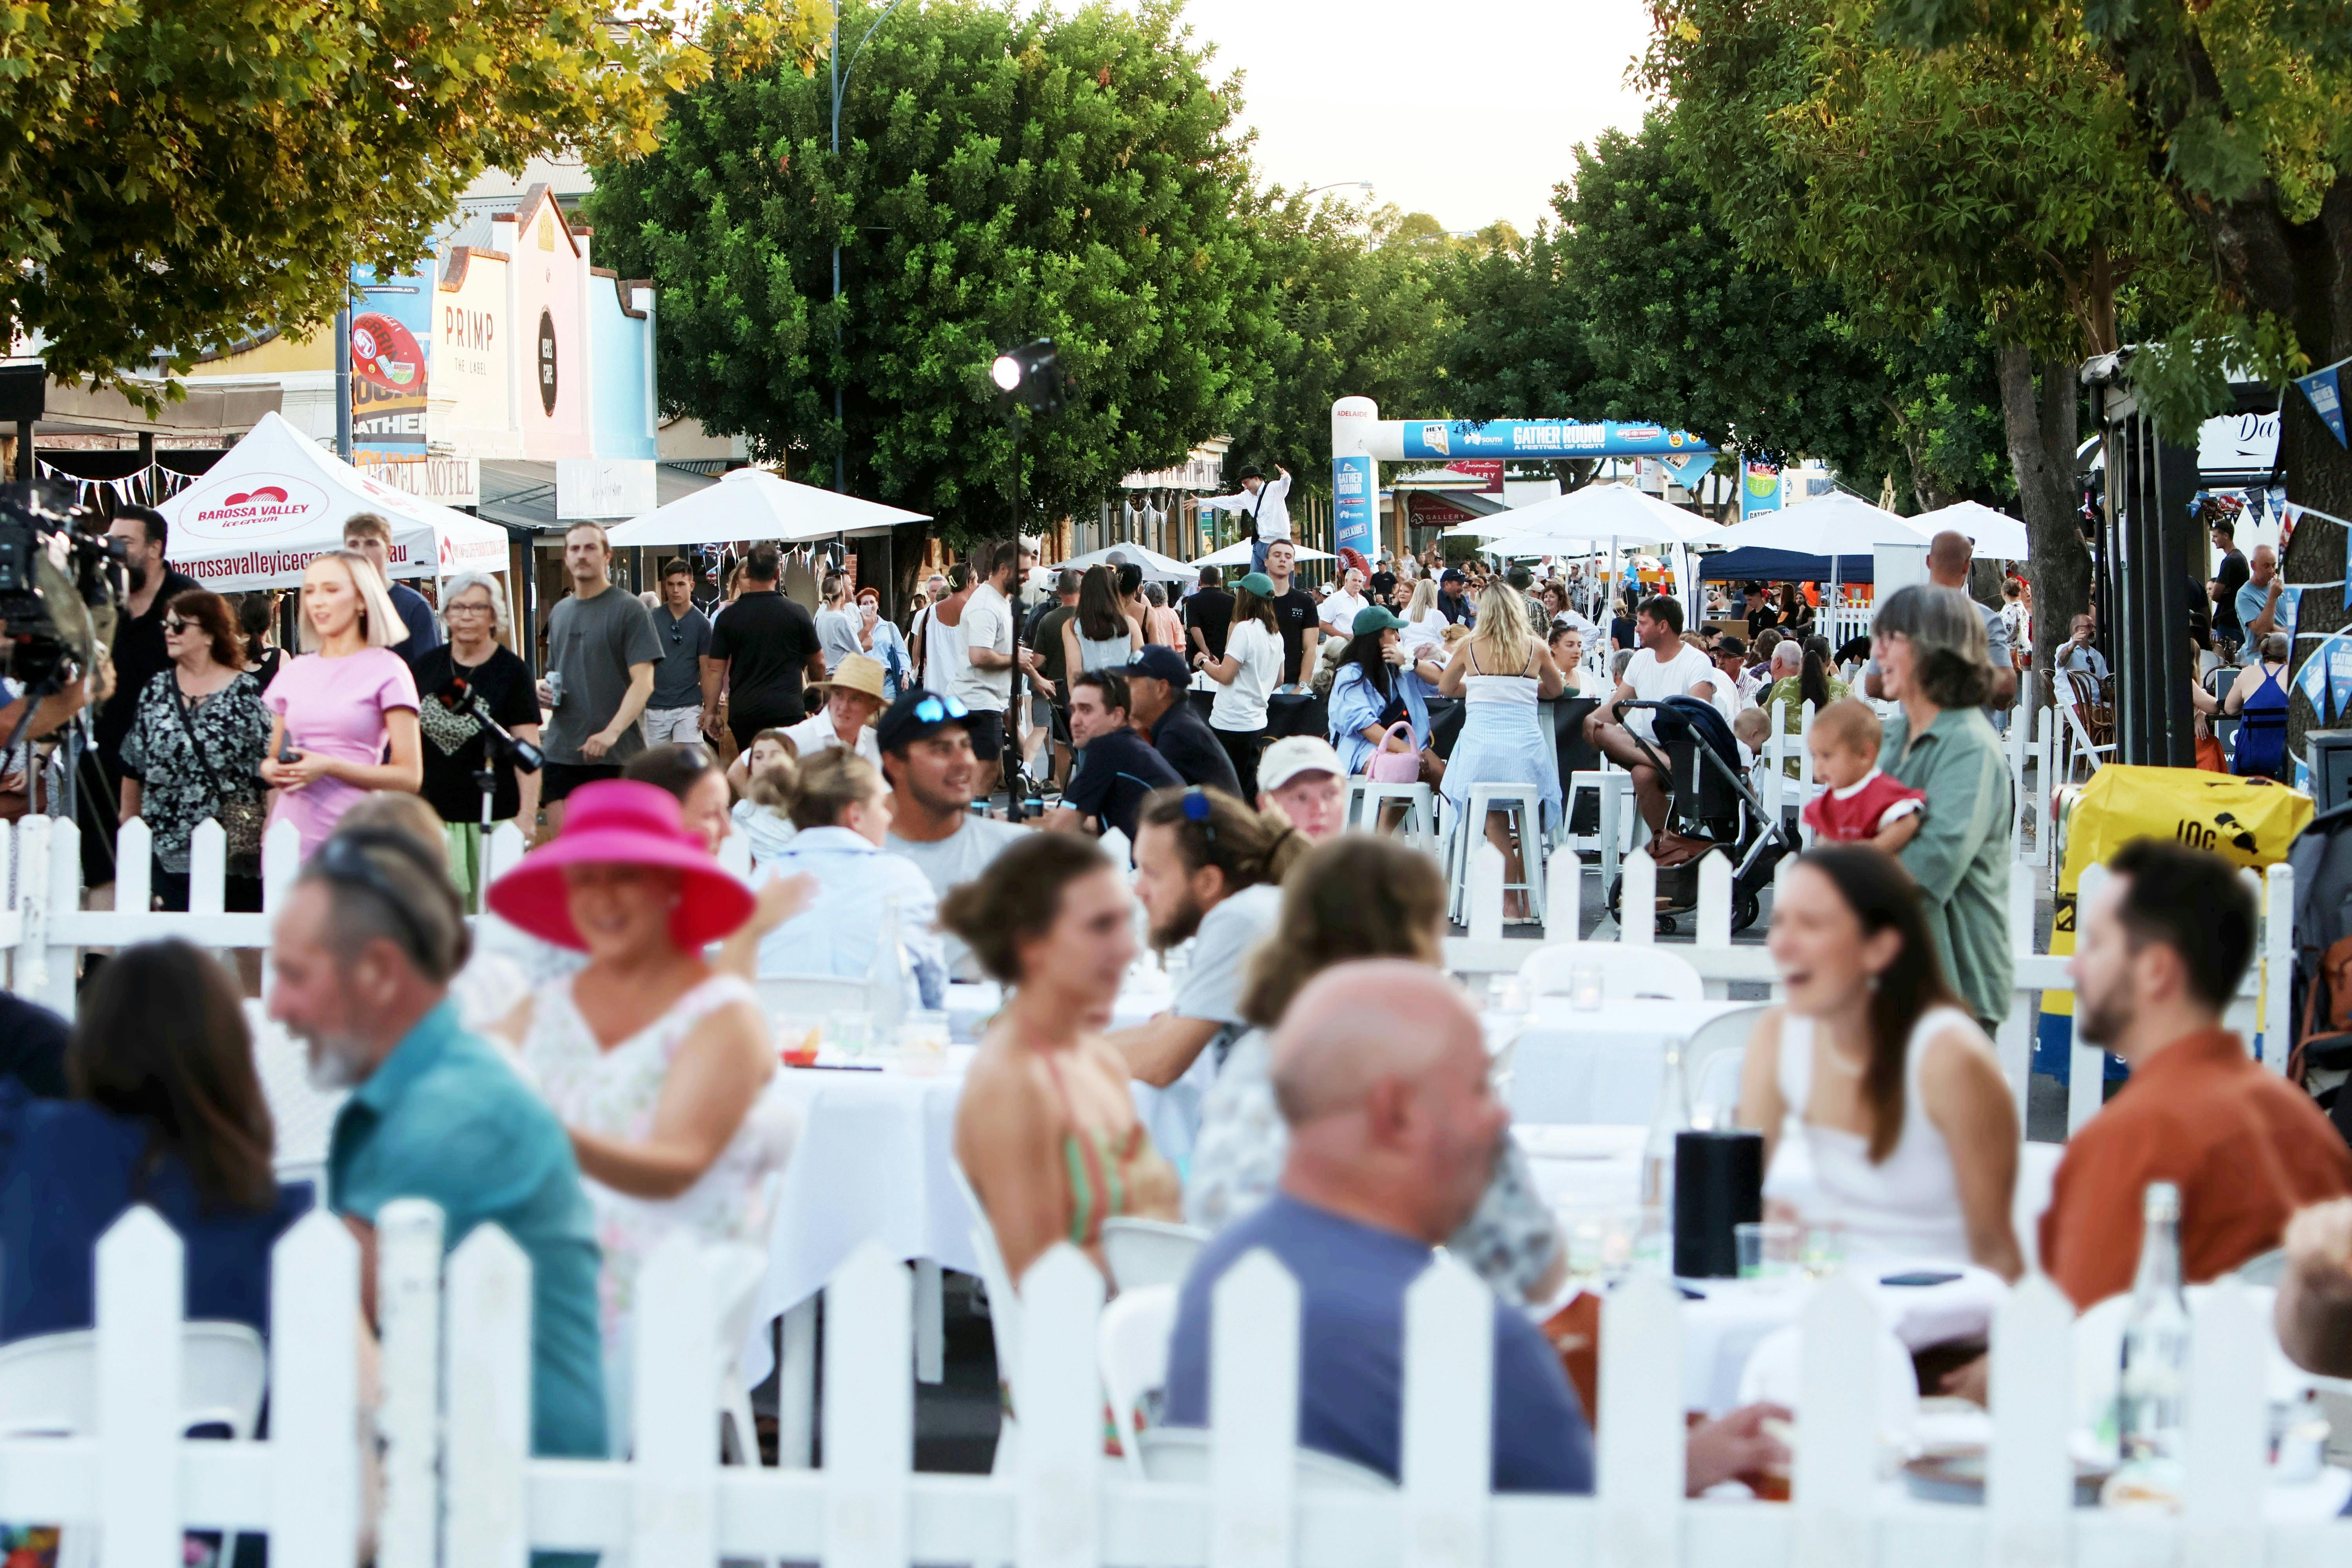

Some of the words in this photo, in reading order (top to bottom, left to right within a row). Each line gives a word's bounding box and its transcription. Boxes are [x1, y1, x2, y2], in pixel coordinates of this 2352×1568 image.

[446, 305, 493, 351] PRIMP
[455, 357, 465, 372] THE
[470, 361, 486, 375] LABEL
[1426, 432, 1445, 445] SA
[1514, 426, 1560, 444] GATHER
[1563, 425, 1605, 444] ROUND
[1462, 461, 1500, 470] Innovations
[425, 461, 474, 496] MOTEL
[1338, 473, 1362, 484] GATHER
[1339, 483, 1362, 494] ROUND
[198, 507, 256, 521] BAROSSA
[261, 505, 309, 515] VALLEY
[1340, 525, 1363, 540] ADELAIDE
